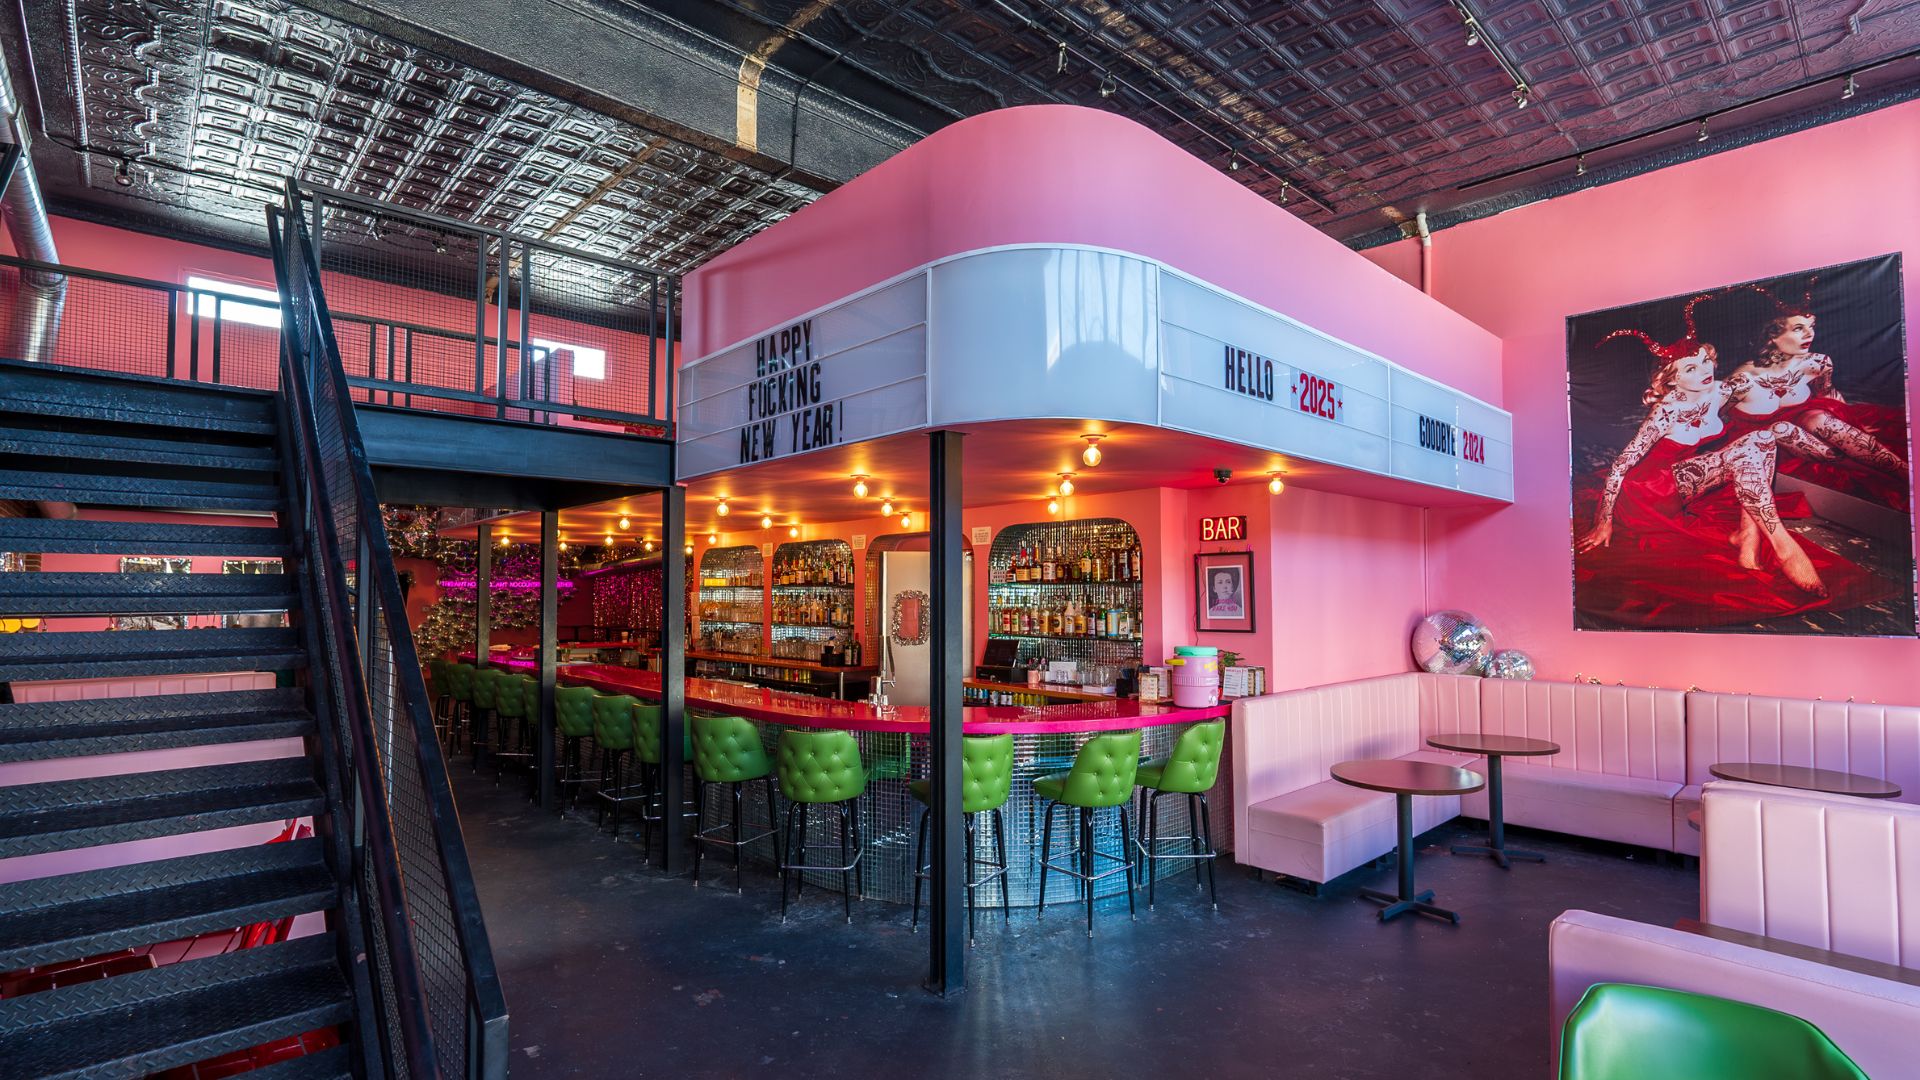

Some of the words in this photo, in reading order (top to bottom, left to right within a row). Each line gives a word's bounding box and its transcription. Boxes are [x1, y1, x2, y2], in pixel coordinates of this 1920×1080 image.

[756, 319, 813, 378] HAPPY
[749, 362, 821, 422] FUCKING
[1224, 345, 1274, 401] HELLO
[1299, 373, 1336, 420] 2025
[740, 420, 777, 465] NEW
[1419, 415, 1457, 457] GOODBYE
[1463, 430, 1485, 465] 2024
[1202, 516, 1241, 541] BAR
